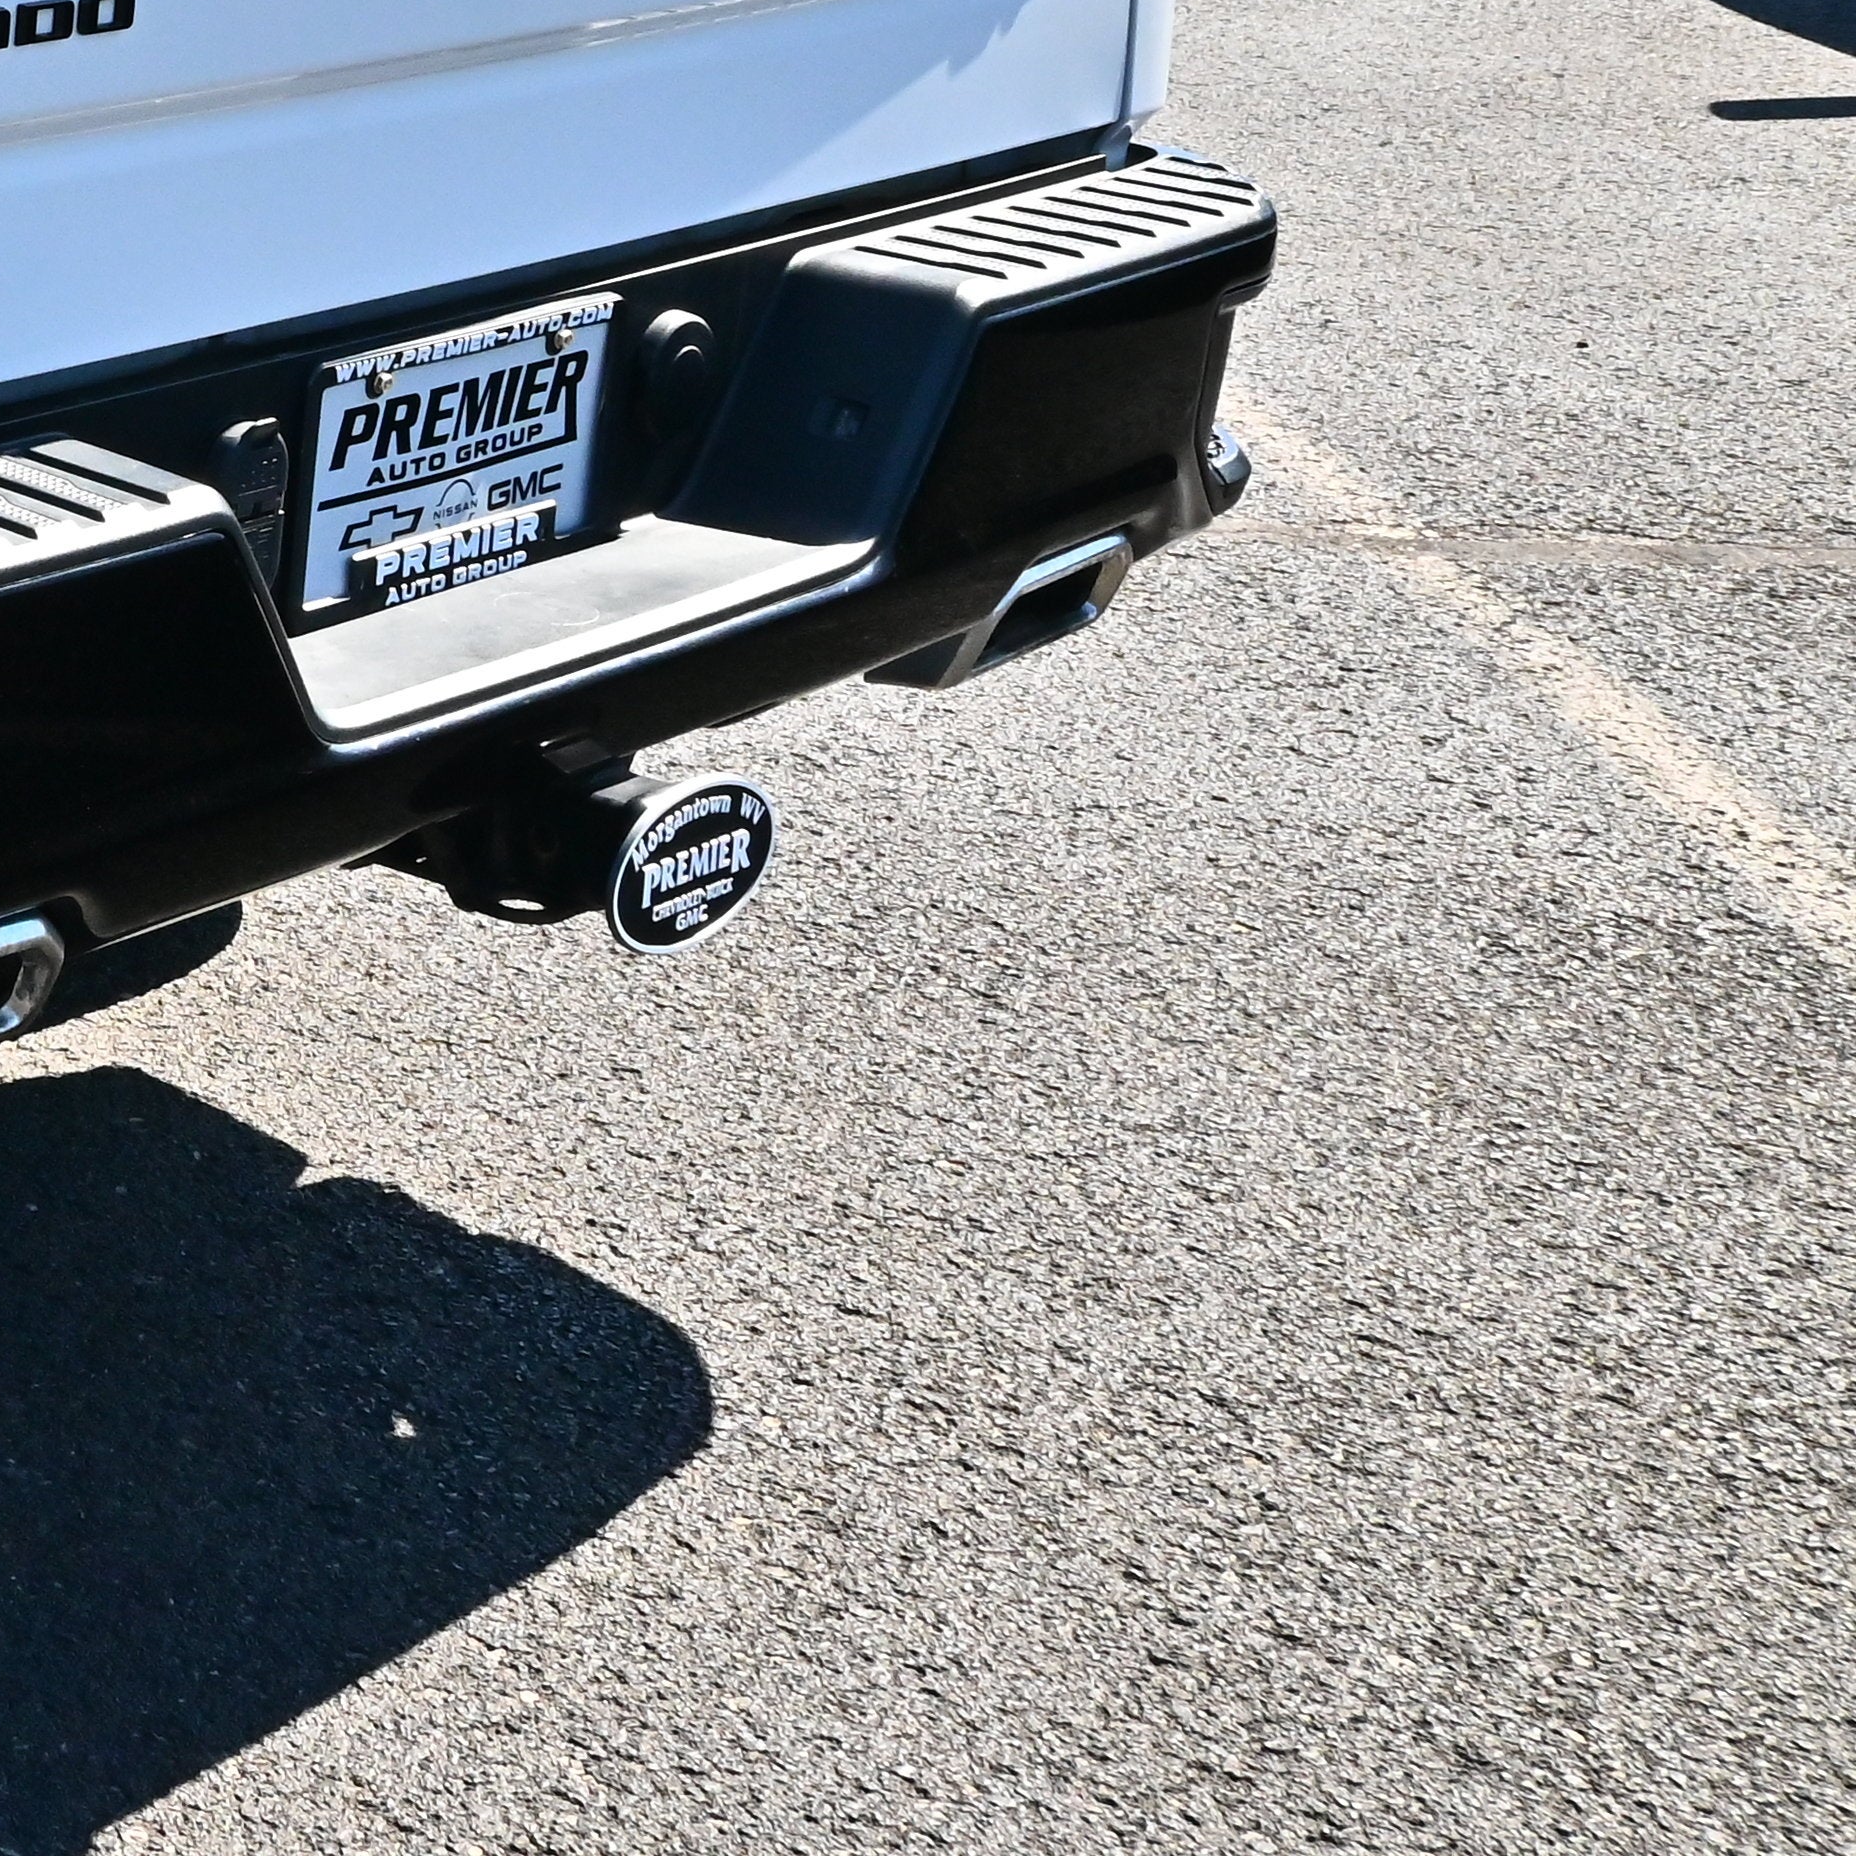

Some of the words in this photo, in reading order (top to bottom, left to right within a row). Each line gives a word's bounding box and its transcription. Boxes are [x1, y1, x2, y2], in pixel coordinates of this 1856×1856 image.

[334, 302, 615, 384] WWW.PREMIER-AUTO.COM
[328, 349, 589, 472] PREMIER
[366, 450, 446, 487] AUTO
[455, 422, 543, 464] GROUP
[487, 463, 564, 512] GMC
[433, 498, 479, 521] NISSAN
[375, 512, 541, 587] PREMIER
[385, 572, 446, 606] AUTO
[452, 550, 528, 584] GROUP
[630, 794, 732, 873] Morgantown
[739, 792, 767, 826] WV
[641, 827, 752, 910] PREMIER
[674, 903, 709, 932] GMC
